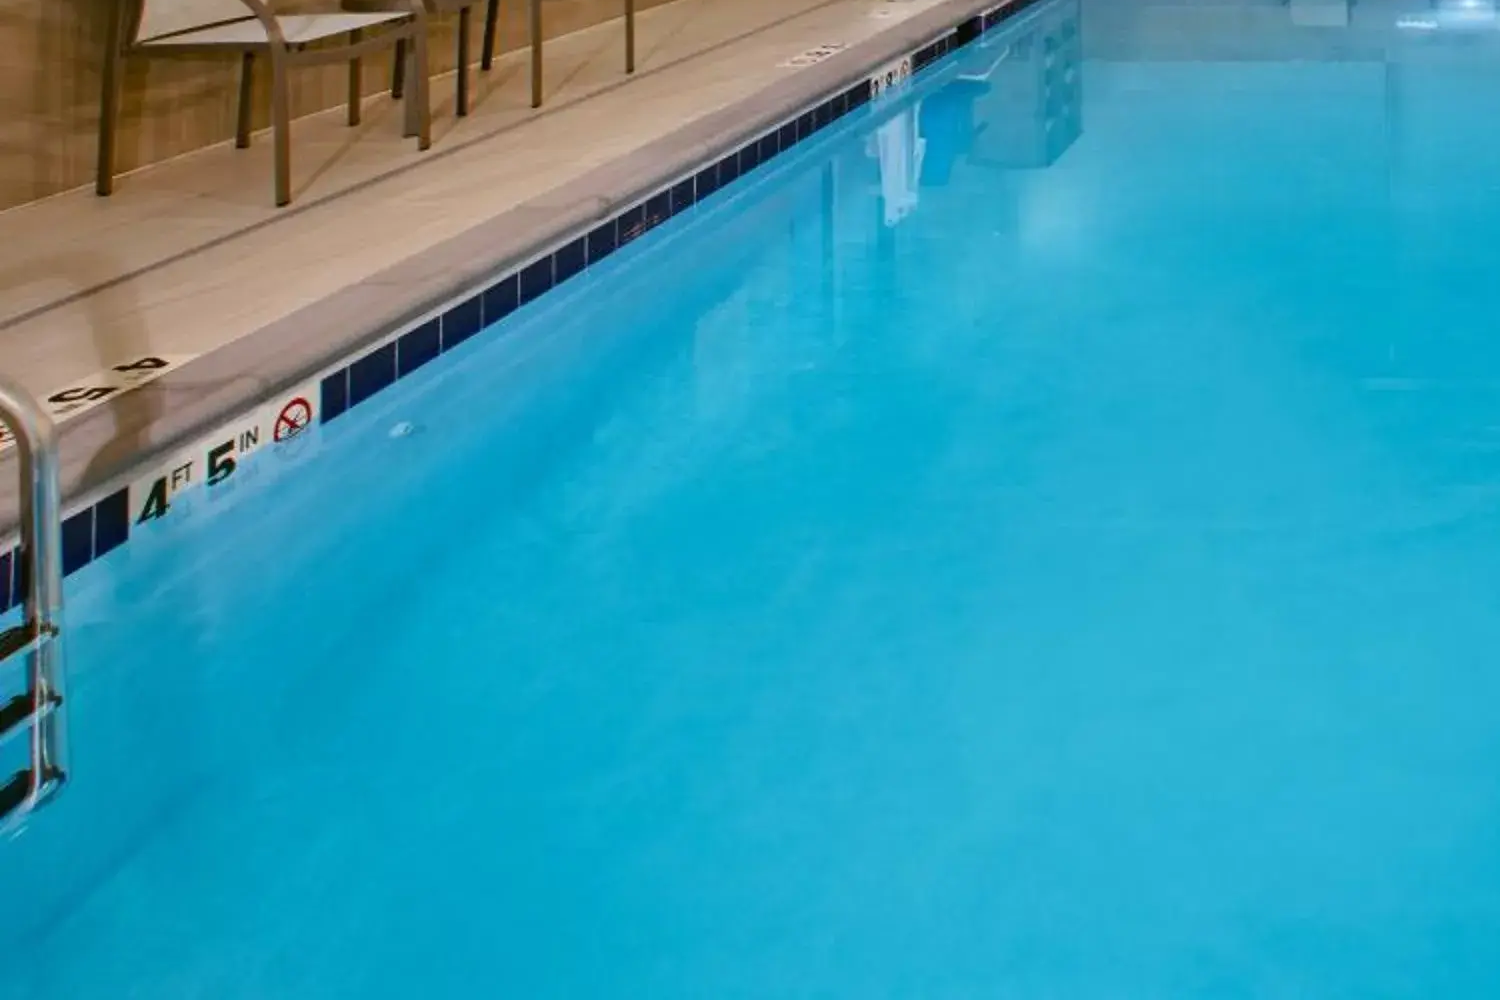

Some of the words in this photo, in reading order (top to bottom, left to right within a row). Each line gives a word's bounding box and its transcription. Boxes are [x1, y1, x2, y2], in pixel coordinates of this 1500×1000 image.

[137, 475, 171, 525] 4
[171, 462, 194, 491] FT
[207, 440, 236, 487] 5
[239, 426, 260, 453] IN
